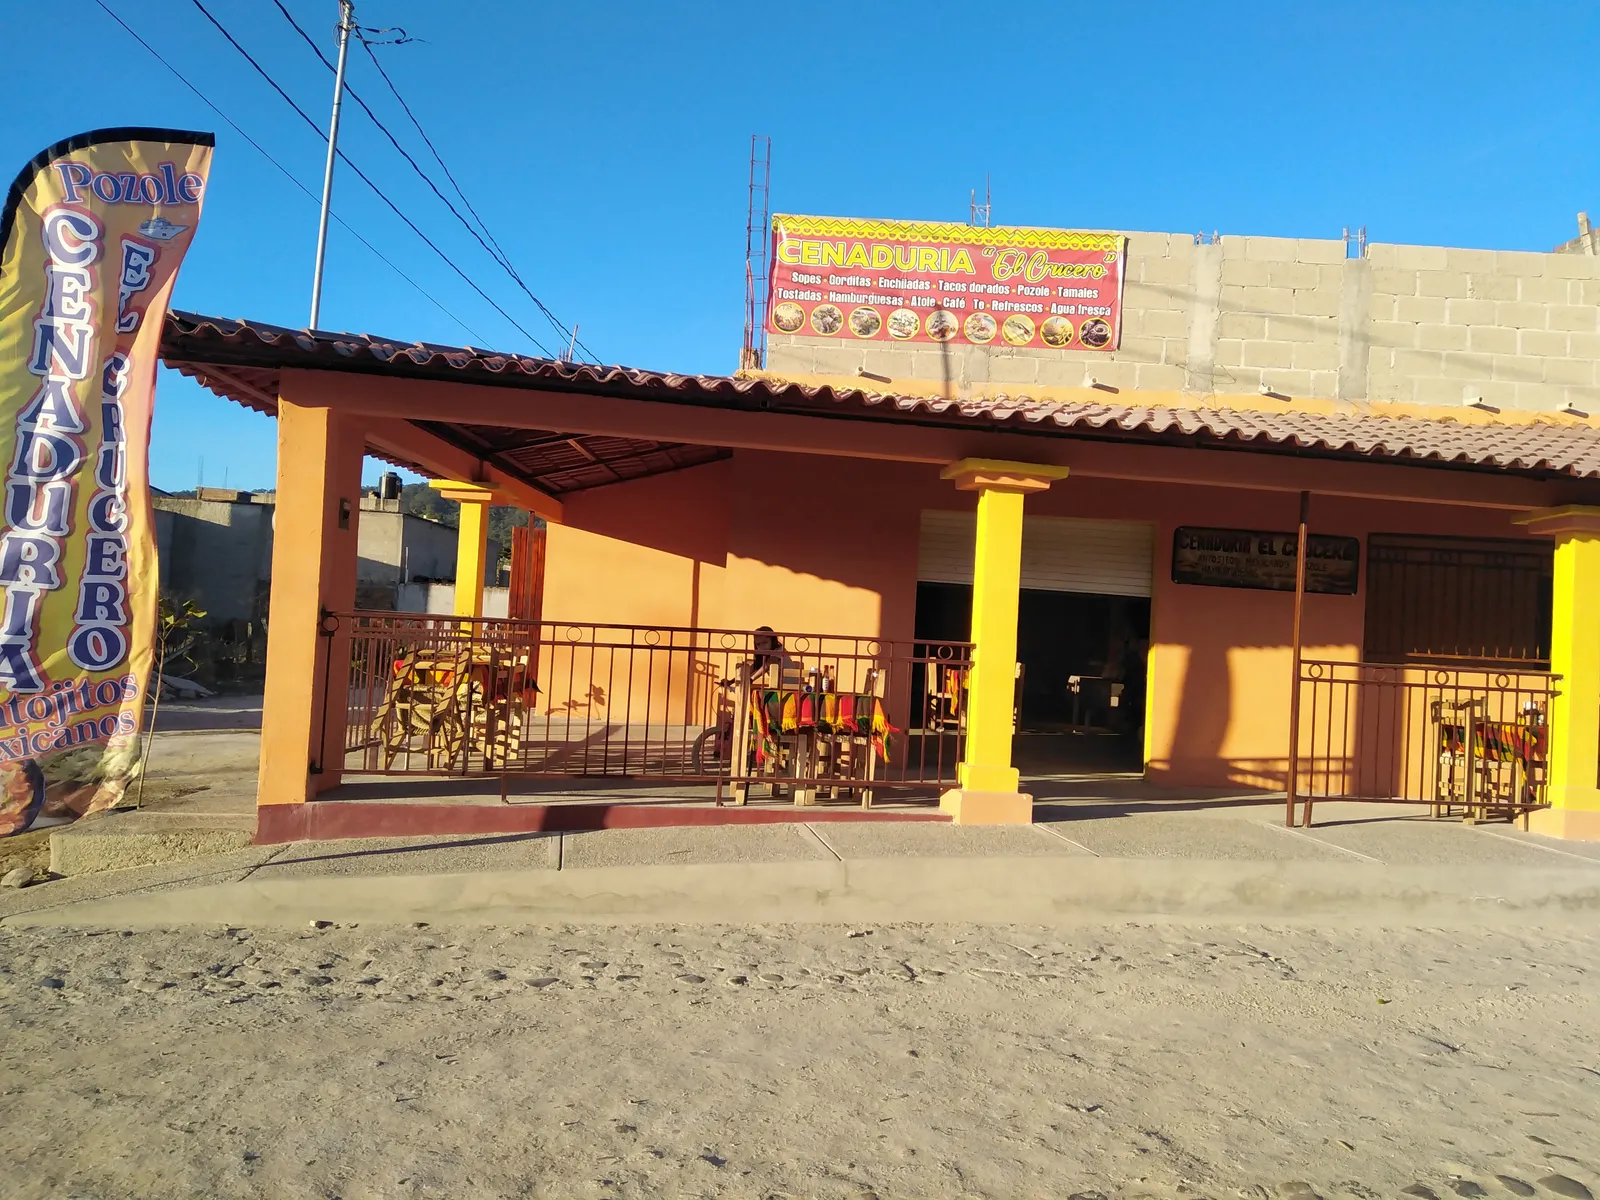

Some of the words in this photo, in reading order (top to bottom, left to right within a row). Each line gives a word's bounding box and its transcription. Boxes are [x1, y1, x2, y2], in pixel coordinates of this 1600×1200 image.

[54, 162, 204, 205] Pozole
[777, 238, 976, 275] CENADURIA
[116, 239, 155, 332] EL
[777, 287, 822, 301] Tostadas
[829, 291, 904, 306] Hamburguesas
[910, 295, 936, 307] Atole
[943, 297, 966, 309] Café
[973, 298, 985, 310] Te
[991, 300, 1043, 313] Refrescos
[1050, 302, 1079, 315] Agua
[1078, 303, 1112, 316] fresca
[791, 272, 822, 286] Sopes
[828, 274, 872, 287] Gorditas
[878, 277, 931, 291] Enchiladas
[938, 280, 967, 292] Tacos
[969, 282, 1011, 295] dorados
[1017, 284, 1050, 297] Pozole
[1057, 286, 1099, 299] Tamales
[0, 209, 99, 693] CENADURIA
[68, 355, 131, 671] CRUCERO
[1257, 536, 1278, 556] EL
